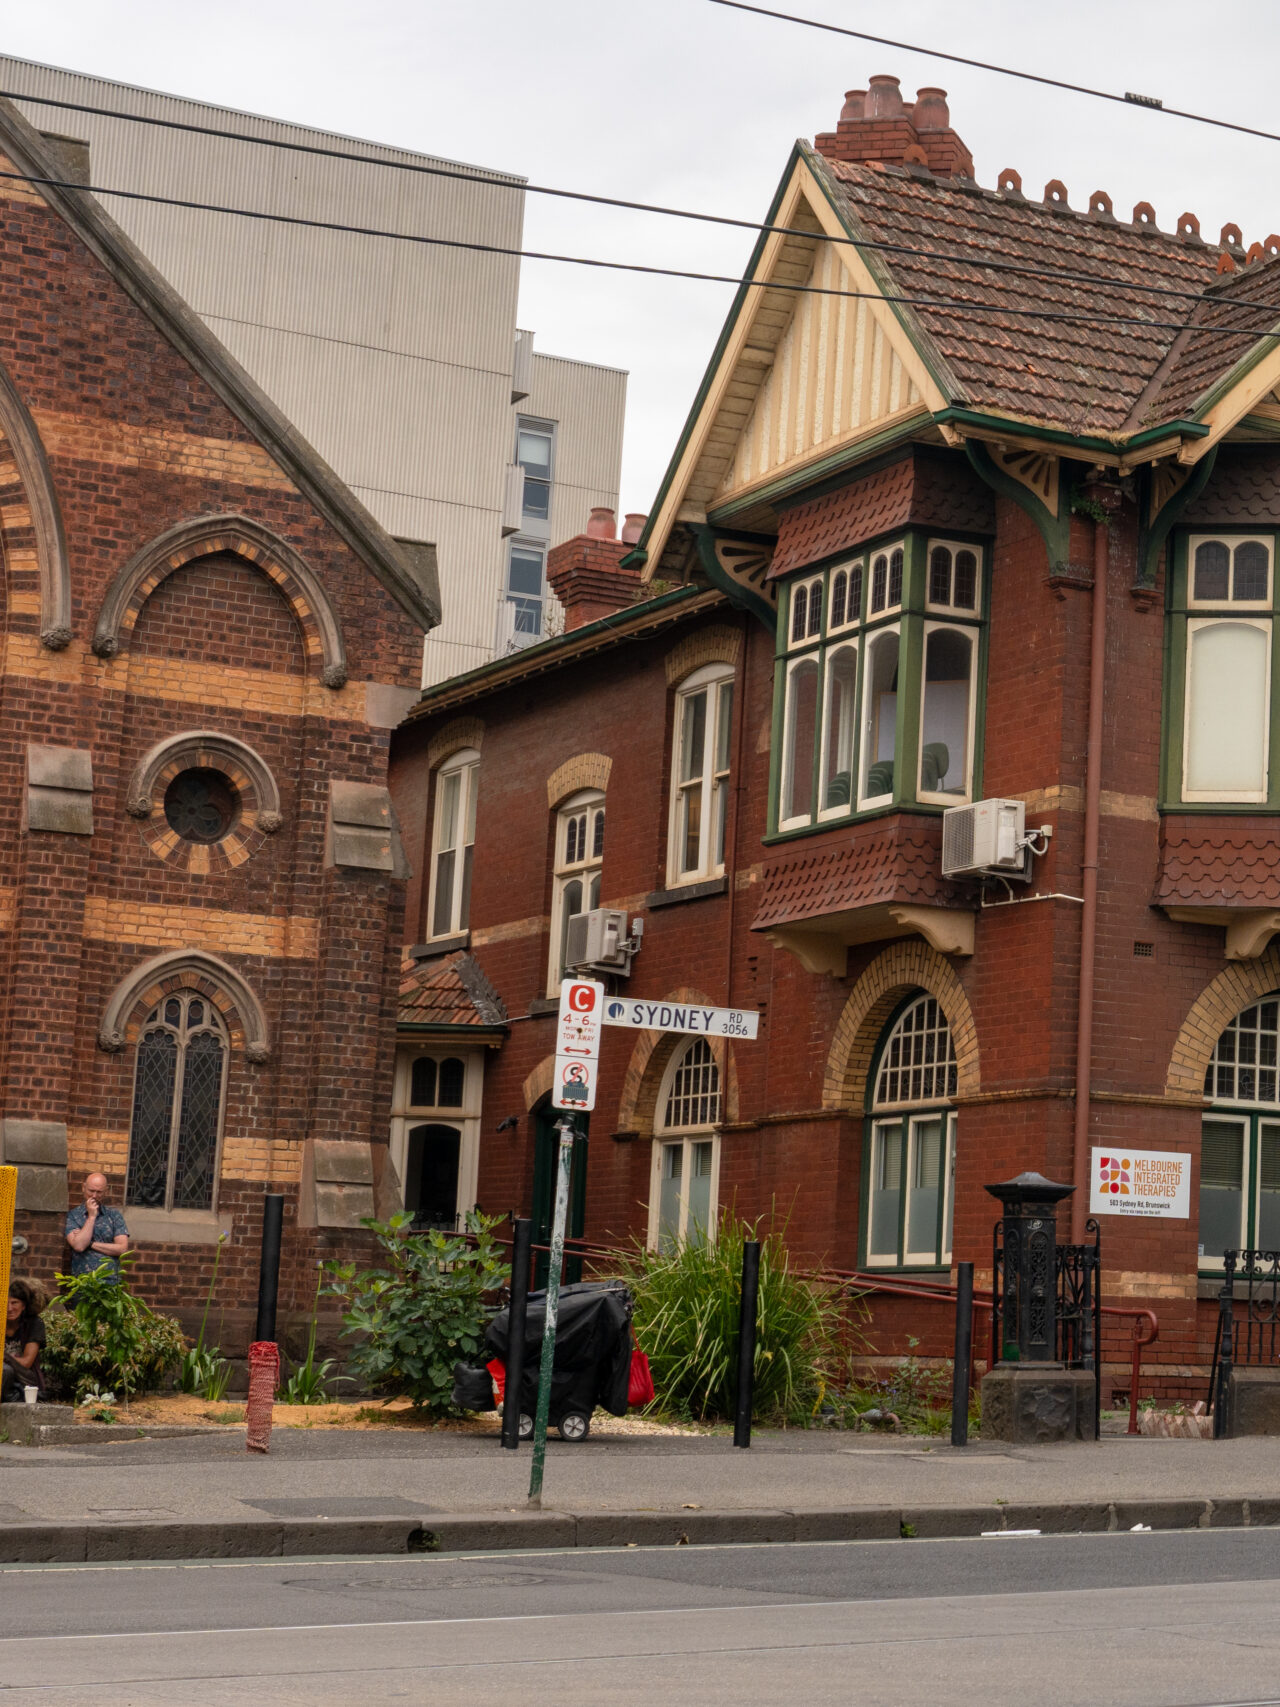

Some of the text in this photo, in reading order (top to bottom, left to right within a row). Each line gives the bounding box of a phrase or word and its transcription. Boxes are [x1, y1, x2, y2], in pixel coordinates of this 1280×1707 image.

[631, 1004, 743, 1032] SYDNEY RD
[562, 1032, 576, 1040] TOW
[721, 1023, 748, 1036] 3056
[1134, 1159, 1183, 1174] MELBOURNE
[1133, 1171, 1181, 1186] INTEGRATED
[1133, 1184, 1176, 1197] THERAPIES
[1119, 1200, 1136, 1208] Sydney
[1145, 1201, 1170, 1209] Brunswick
